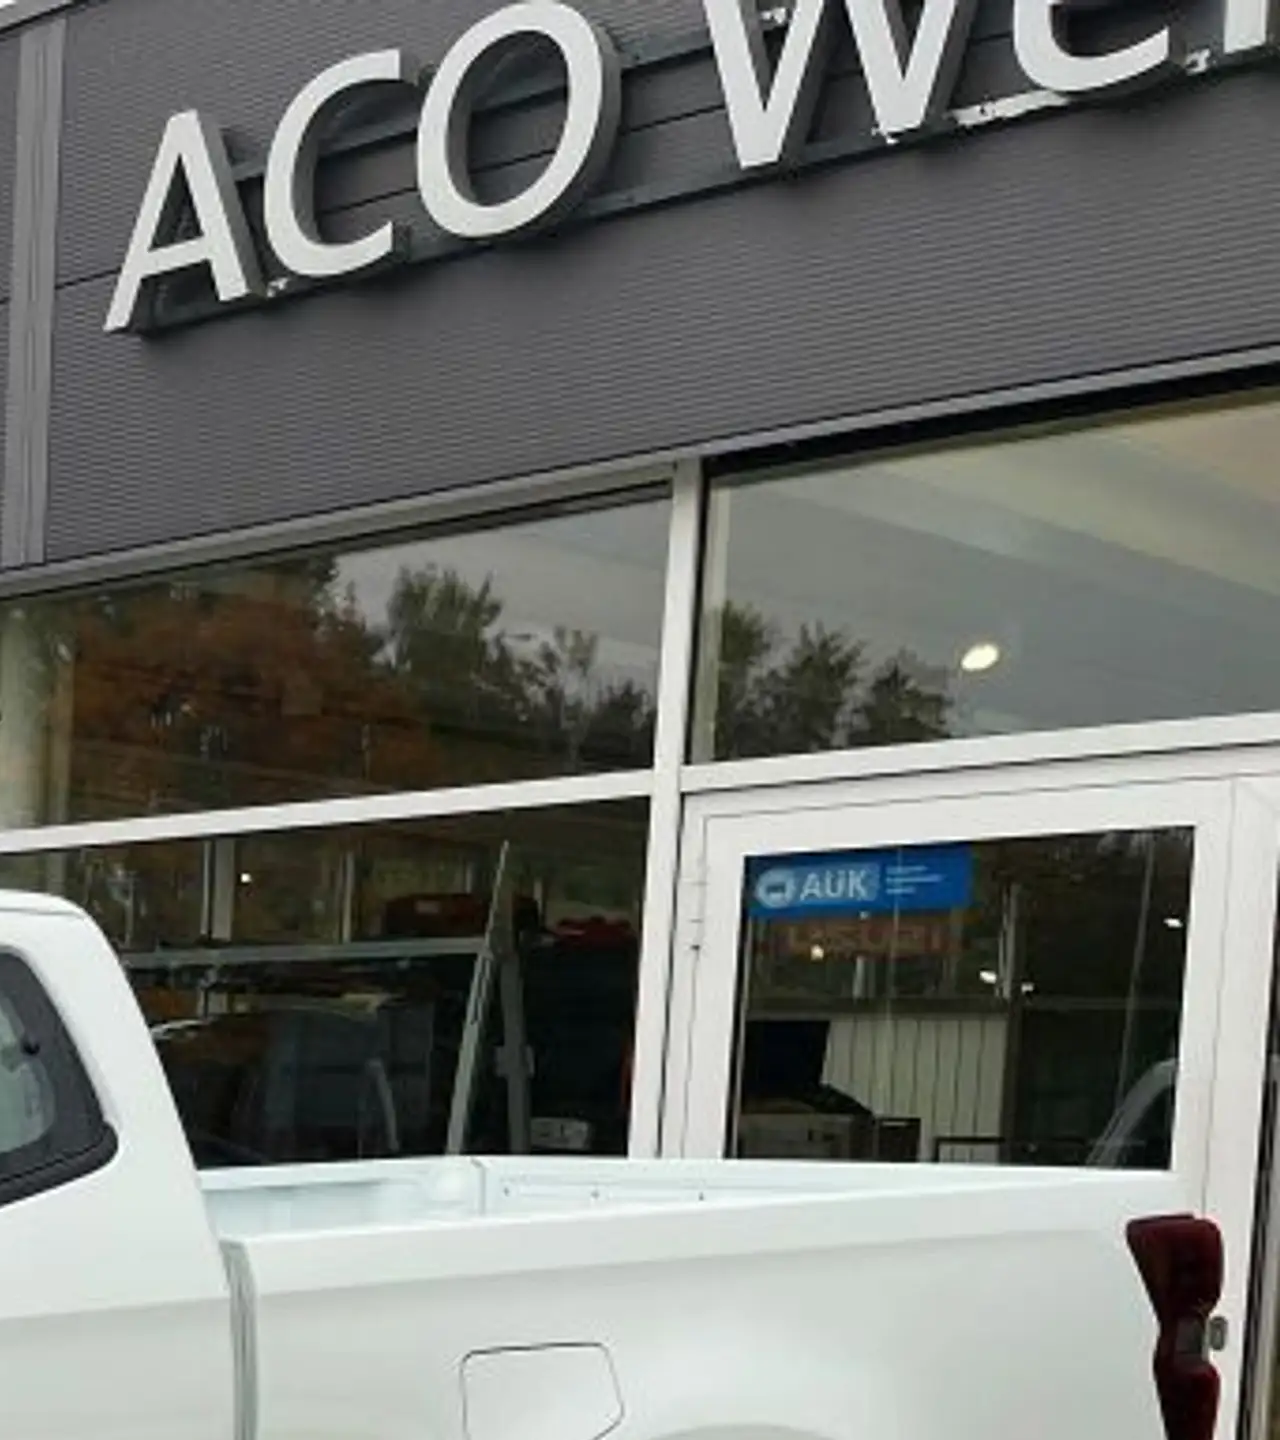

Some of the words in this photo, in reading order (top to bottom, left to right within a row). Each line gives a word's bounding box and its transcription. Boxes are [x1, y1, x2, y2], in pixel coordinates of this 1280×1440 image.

[103, 0, 604, 331] ACO
[704, 0, 1267, 168] We
[800, 870, 869, 901] AUK
